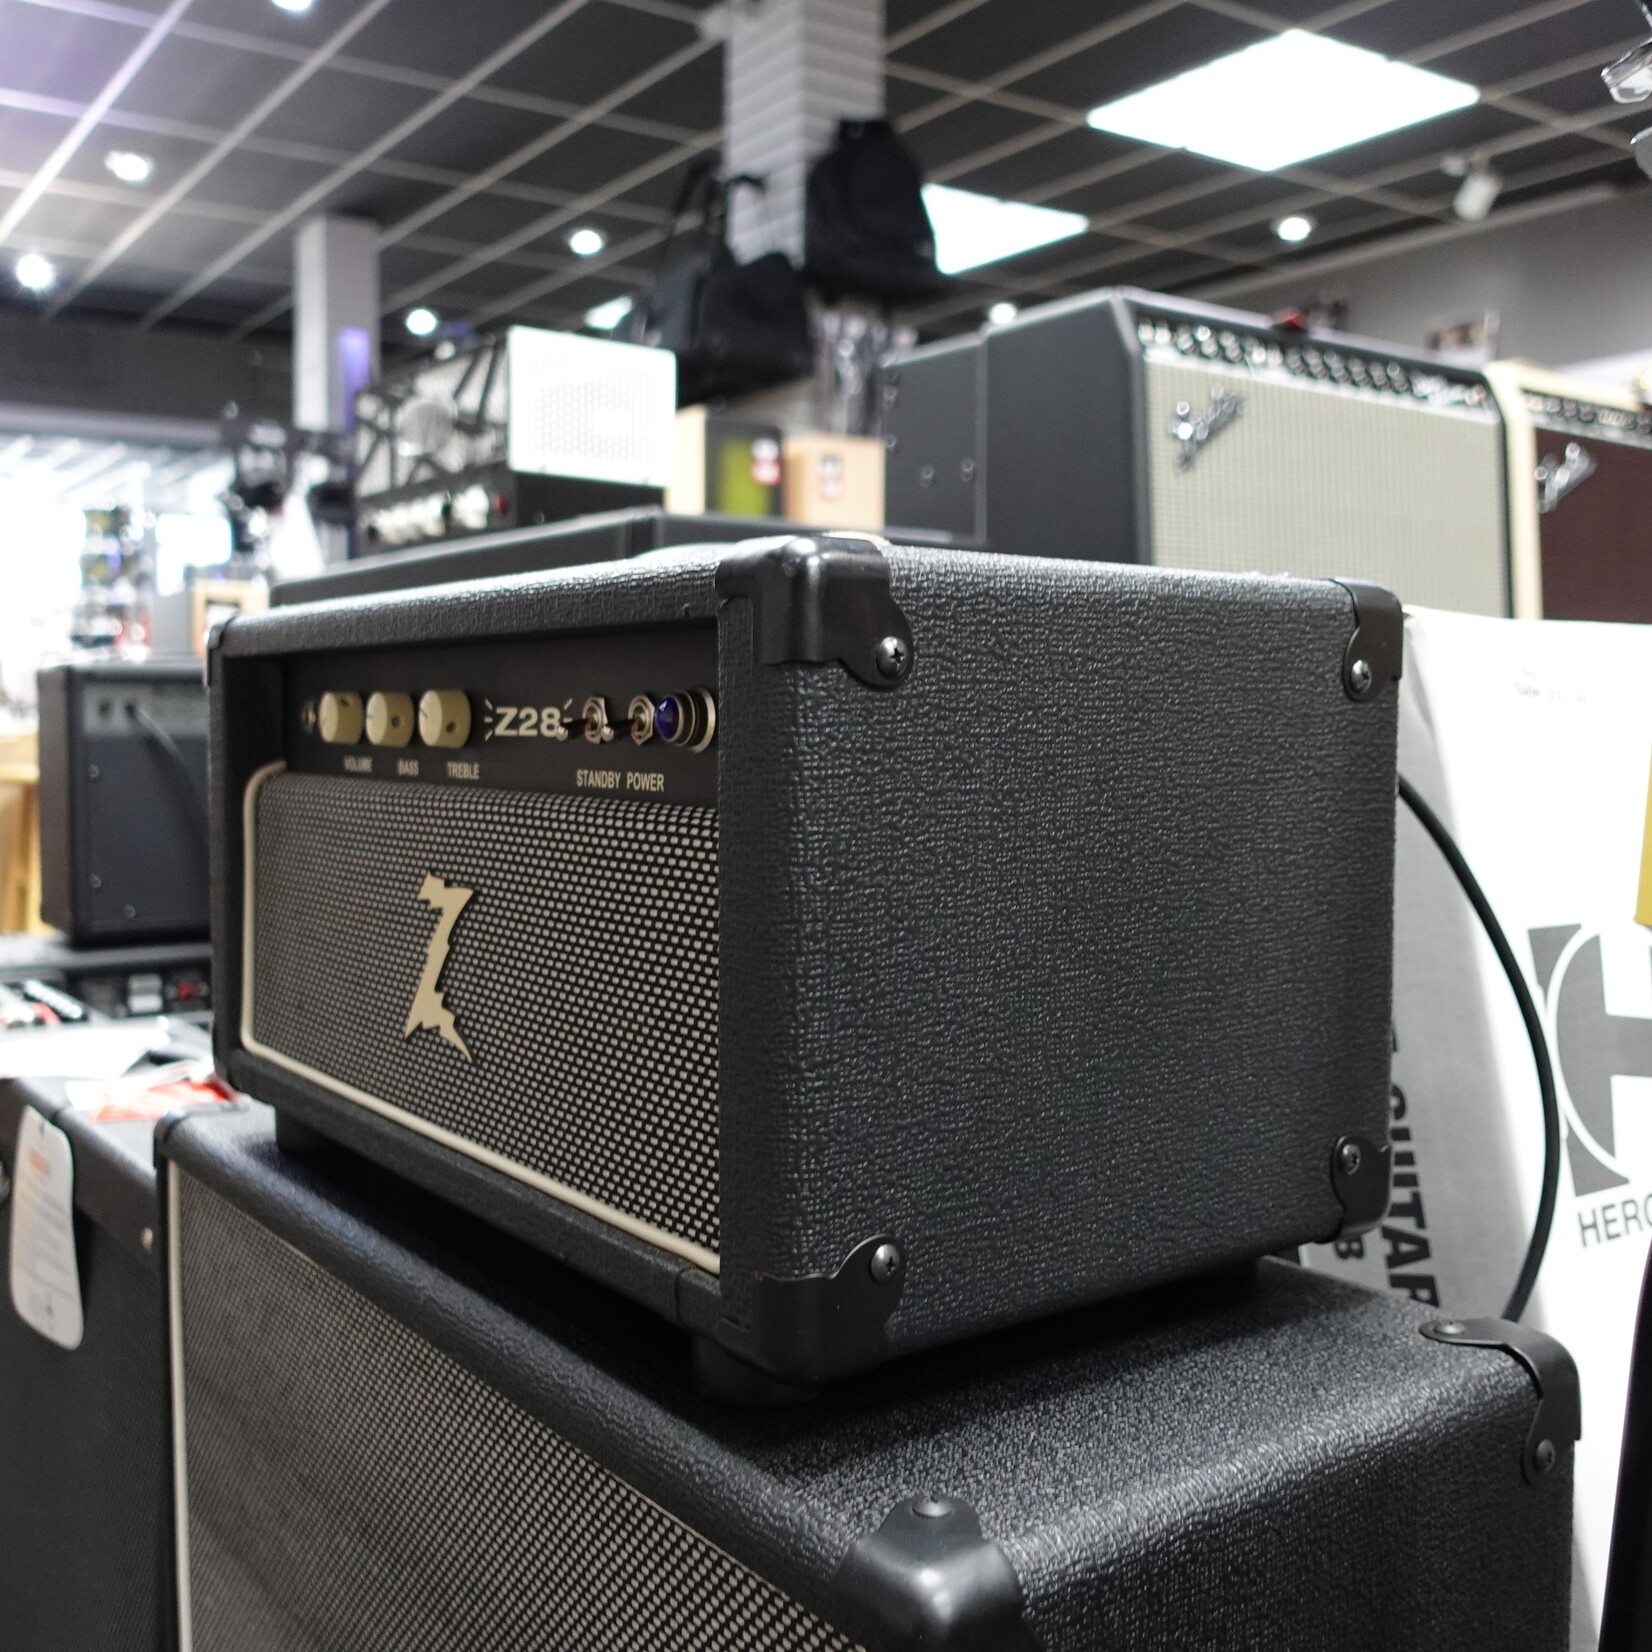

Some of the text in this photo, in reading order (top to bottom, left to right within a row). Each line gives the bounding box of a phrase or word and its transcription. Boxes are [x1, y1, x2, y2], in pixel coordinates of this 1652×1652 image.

[494, 706, 561, 737] Z28
[397, 758, 419, 777] BASS
[447, 760, 480, 780] TREBLE
[576, 768, 622, 789] STANDBY
[627, 772, 665, 792] POWER
